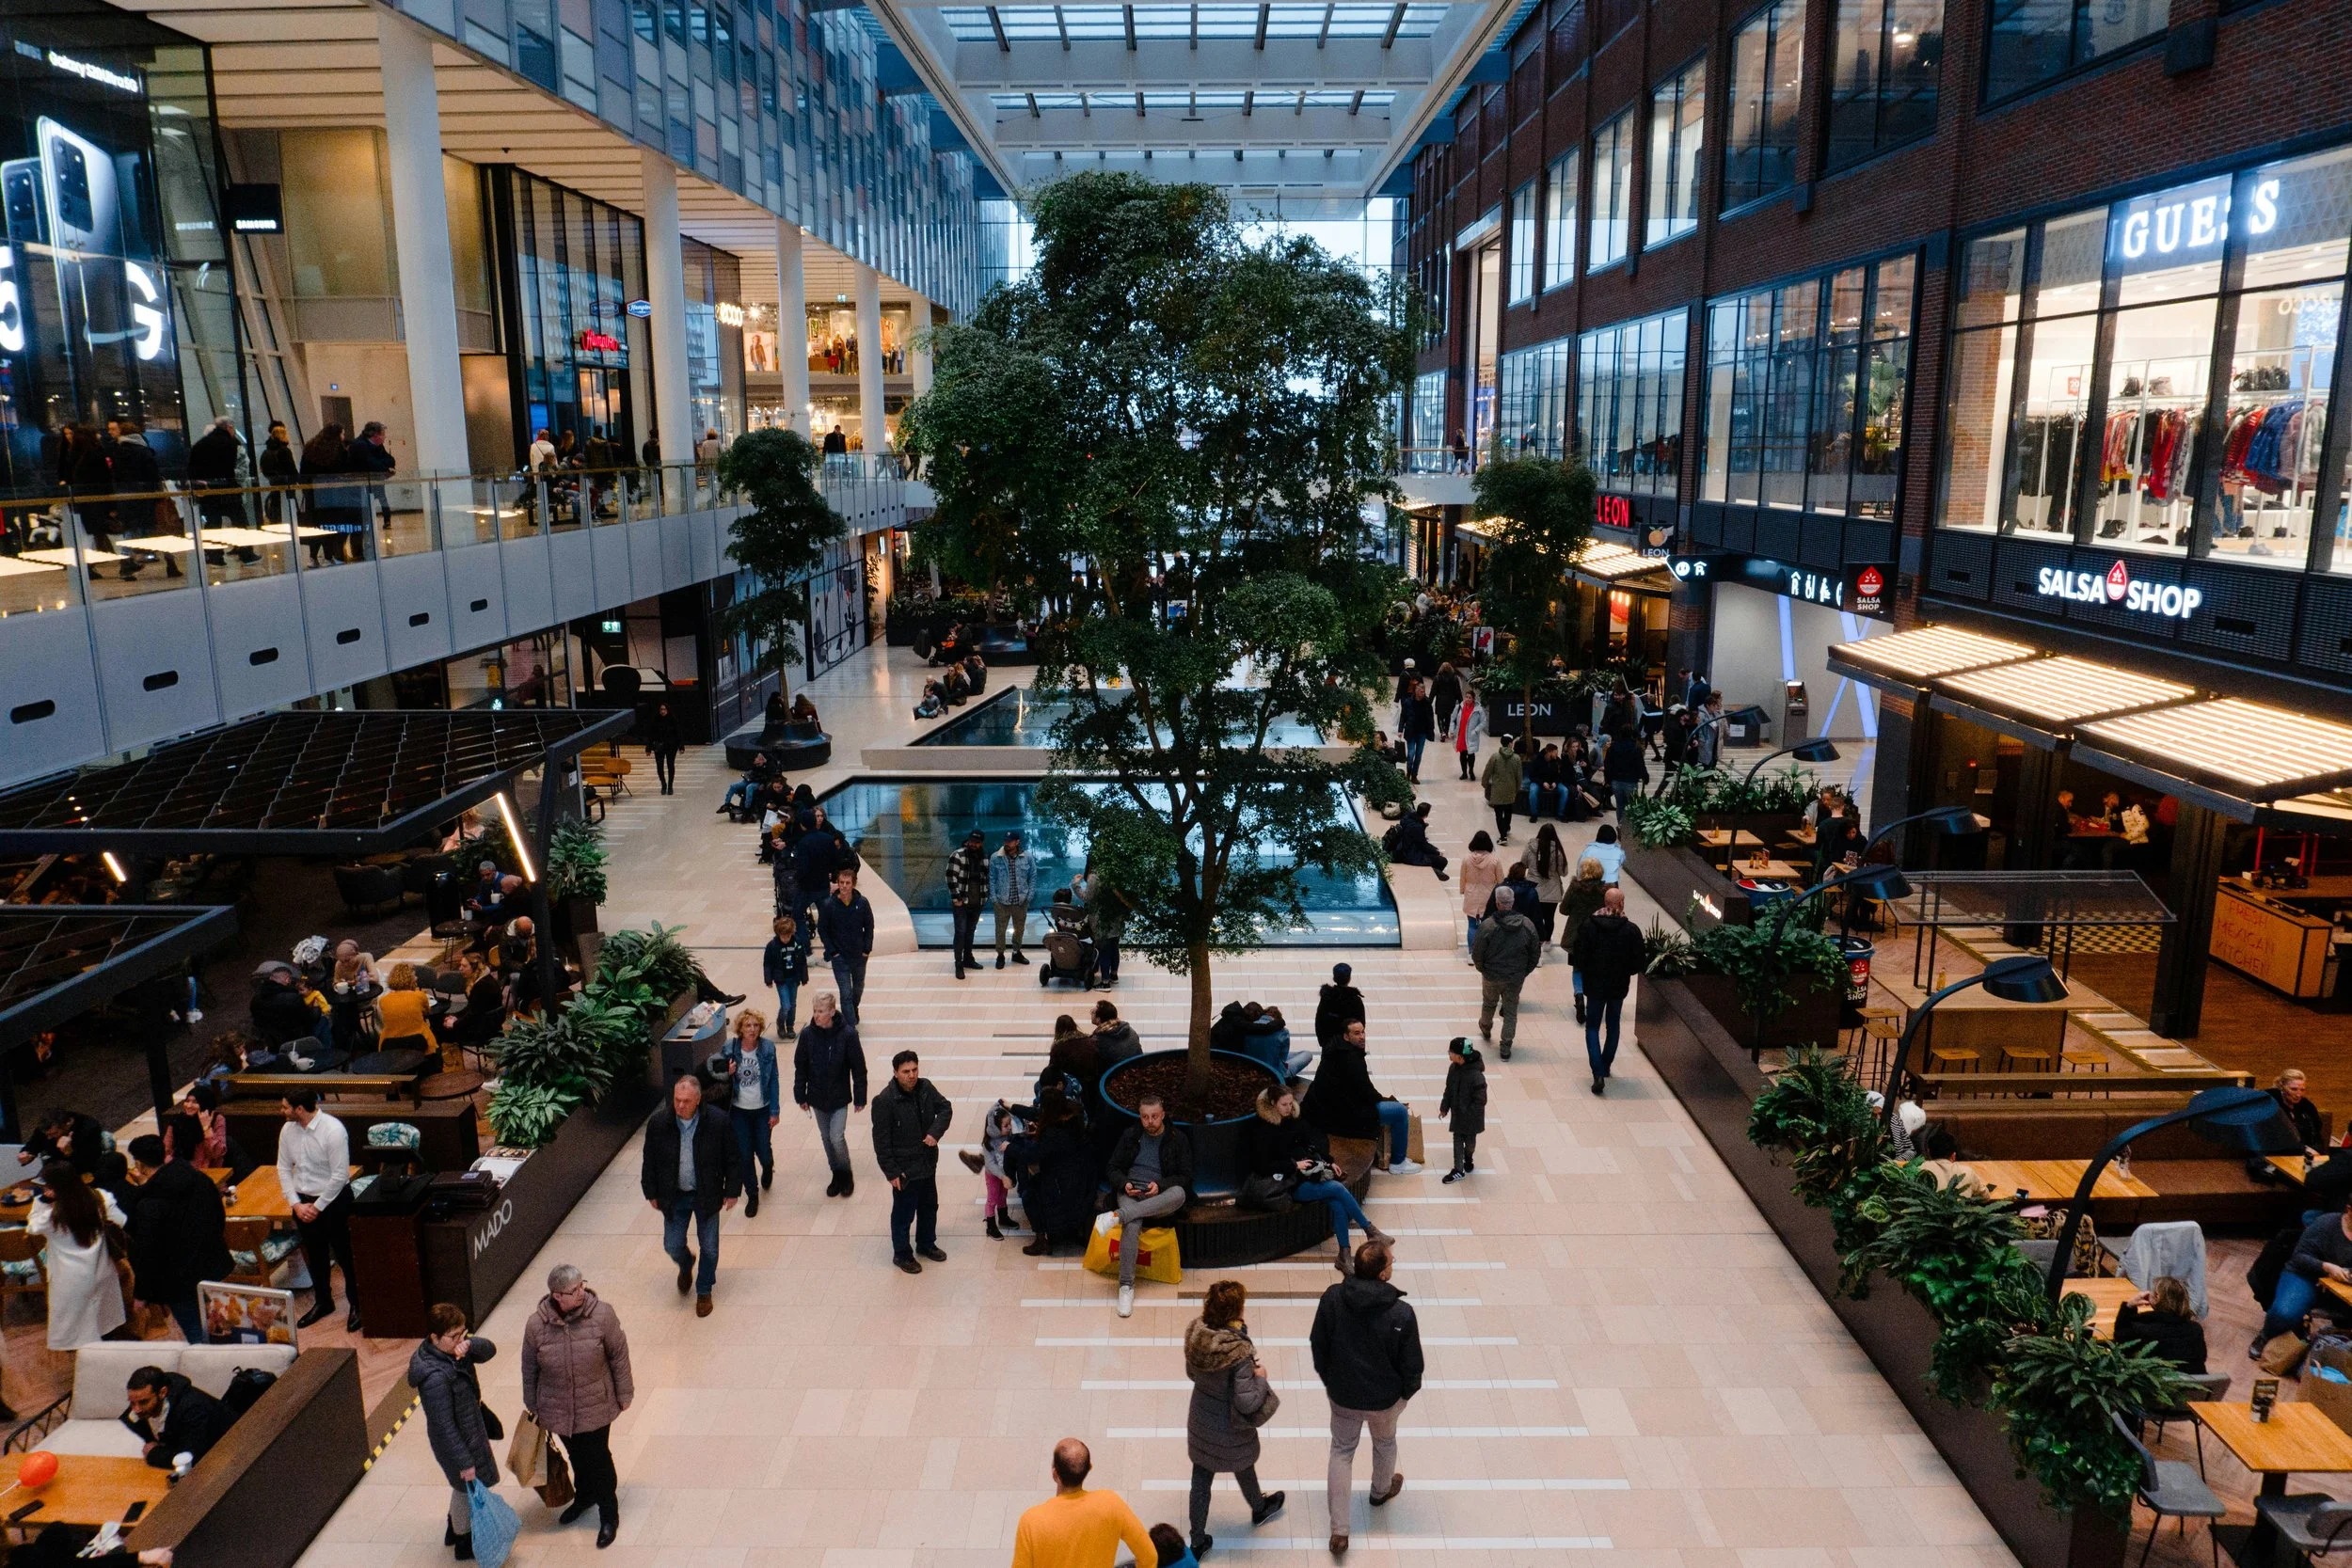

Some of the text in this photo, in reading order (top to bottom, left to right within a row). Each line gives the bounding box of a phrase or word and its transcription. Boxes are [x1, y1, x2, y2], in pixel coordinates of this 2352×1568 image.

[49, 50, 86, 79] Galaxy
[236, 219, 277, 230] SAMSUNG
[580, 329, 619, 352] Hampton
[1597, 496, 1630, 528] LEON
[1642, 548, 1670, 557] LEON
[2038, 567, 2202, 619] SALSA SHOP
[1847, 992, 1867, 1001] SHOP
[474, 1198, 513, 1260] MADO
